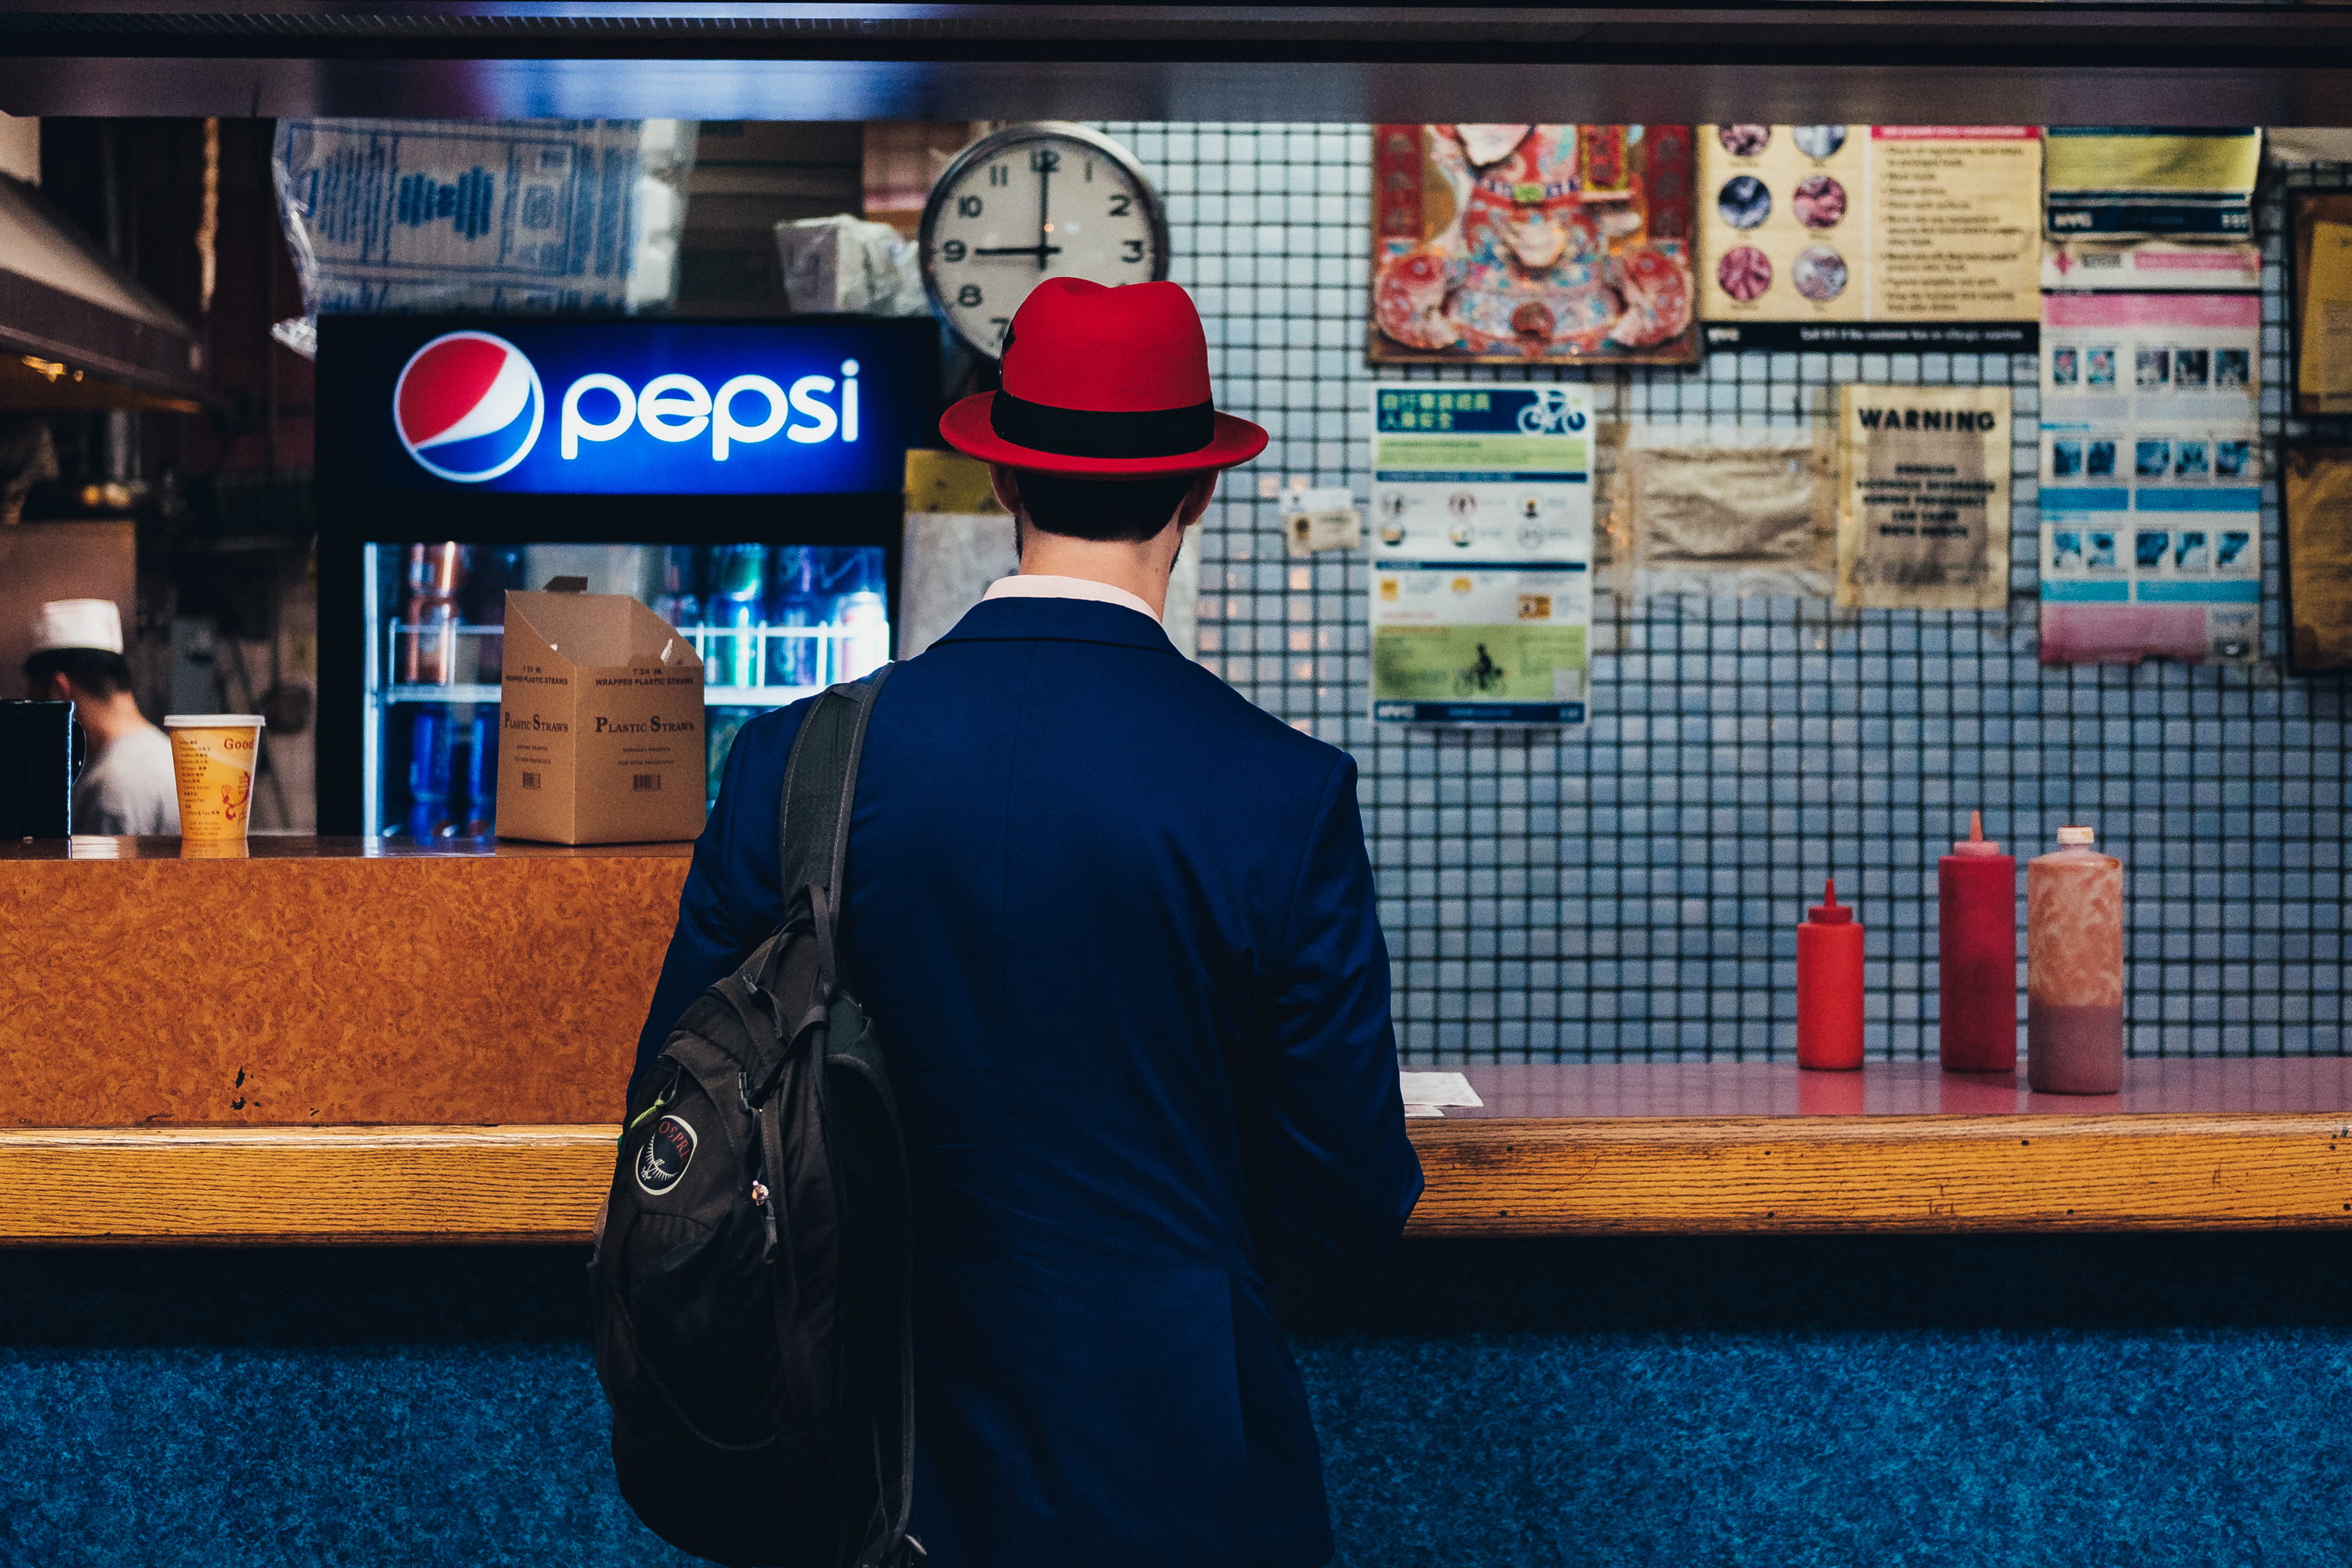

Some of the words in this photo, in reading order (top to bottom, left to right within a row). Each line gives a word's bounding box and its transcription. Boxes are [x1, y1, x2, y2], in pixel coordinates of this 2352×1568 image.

[989, 165, 1008, 187] 11
[1083, 161, 1093, 183] 1
[957, 195, 983, 218] 10
[1109, 194, 1132, 216] 2
[942, 239, 967, 263] 9
[1120, 240, 1143, 263] 3
[958, 284, 983, 307] 8
[561, 358, 860, 462] pepsi
[1858, 407, 1996, 431] WARNING
[544, 677, 568, 686] STRAWS
[223, 738, 255, 751] Good
